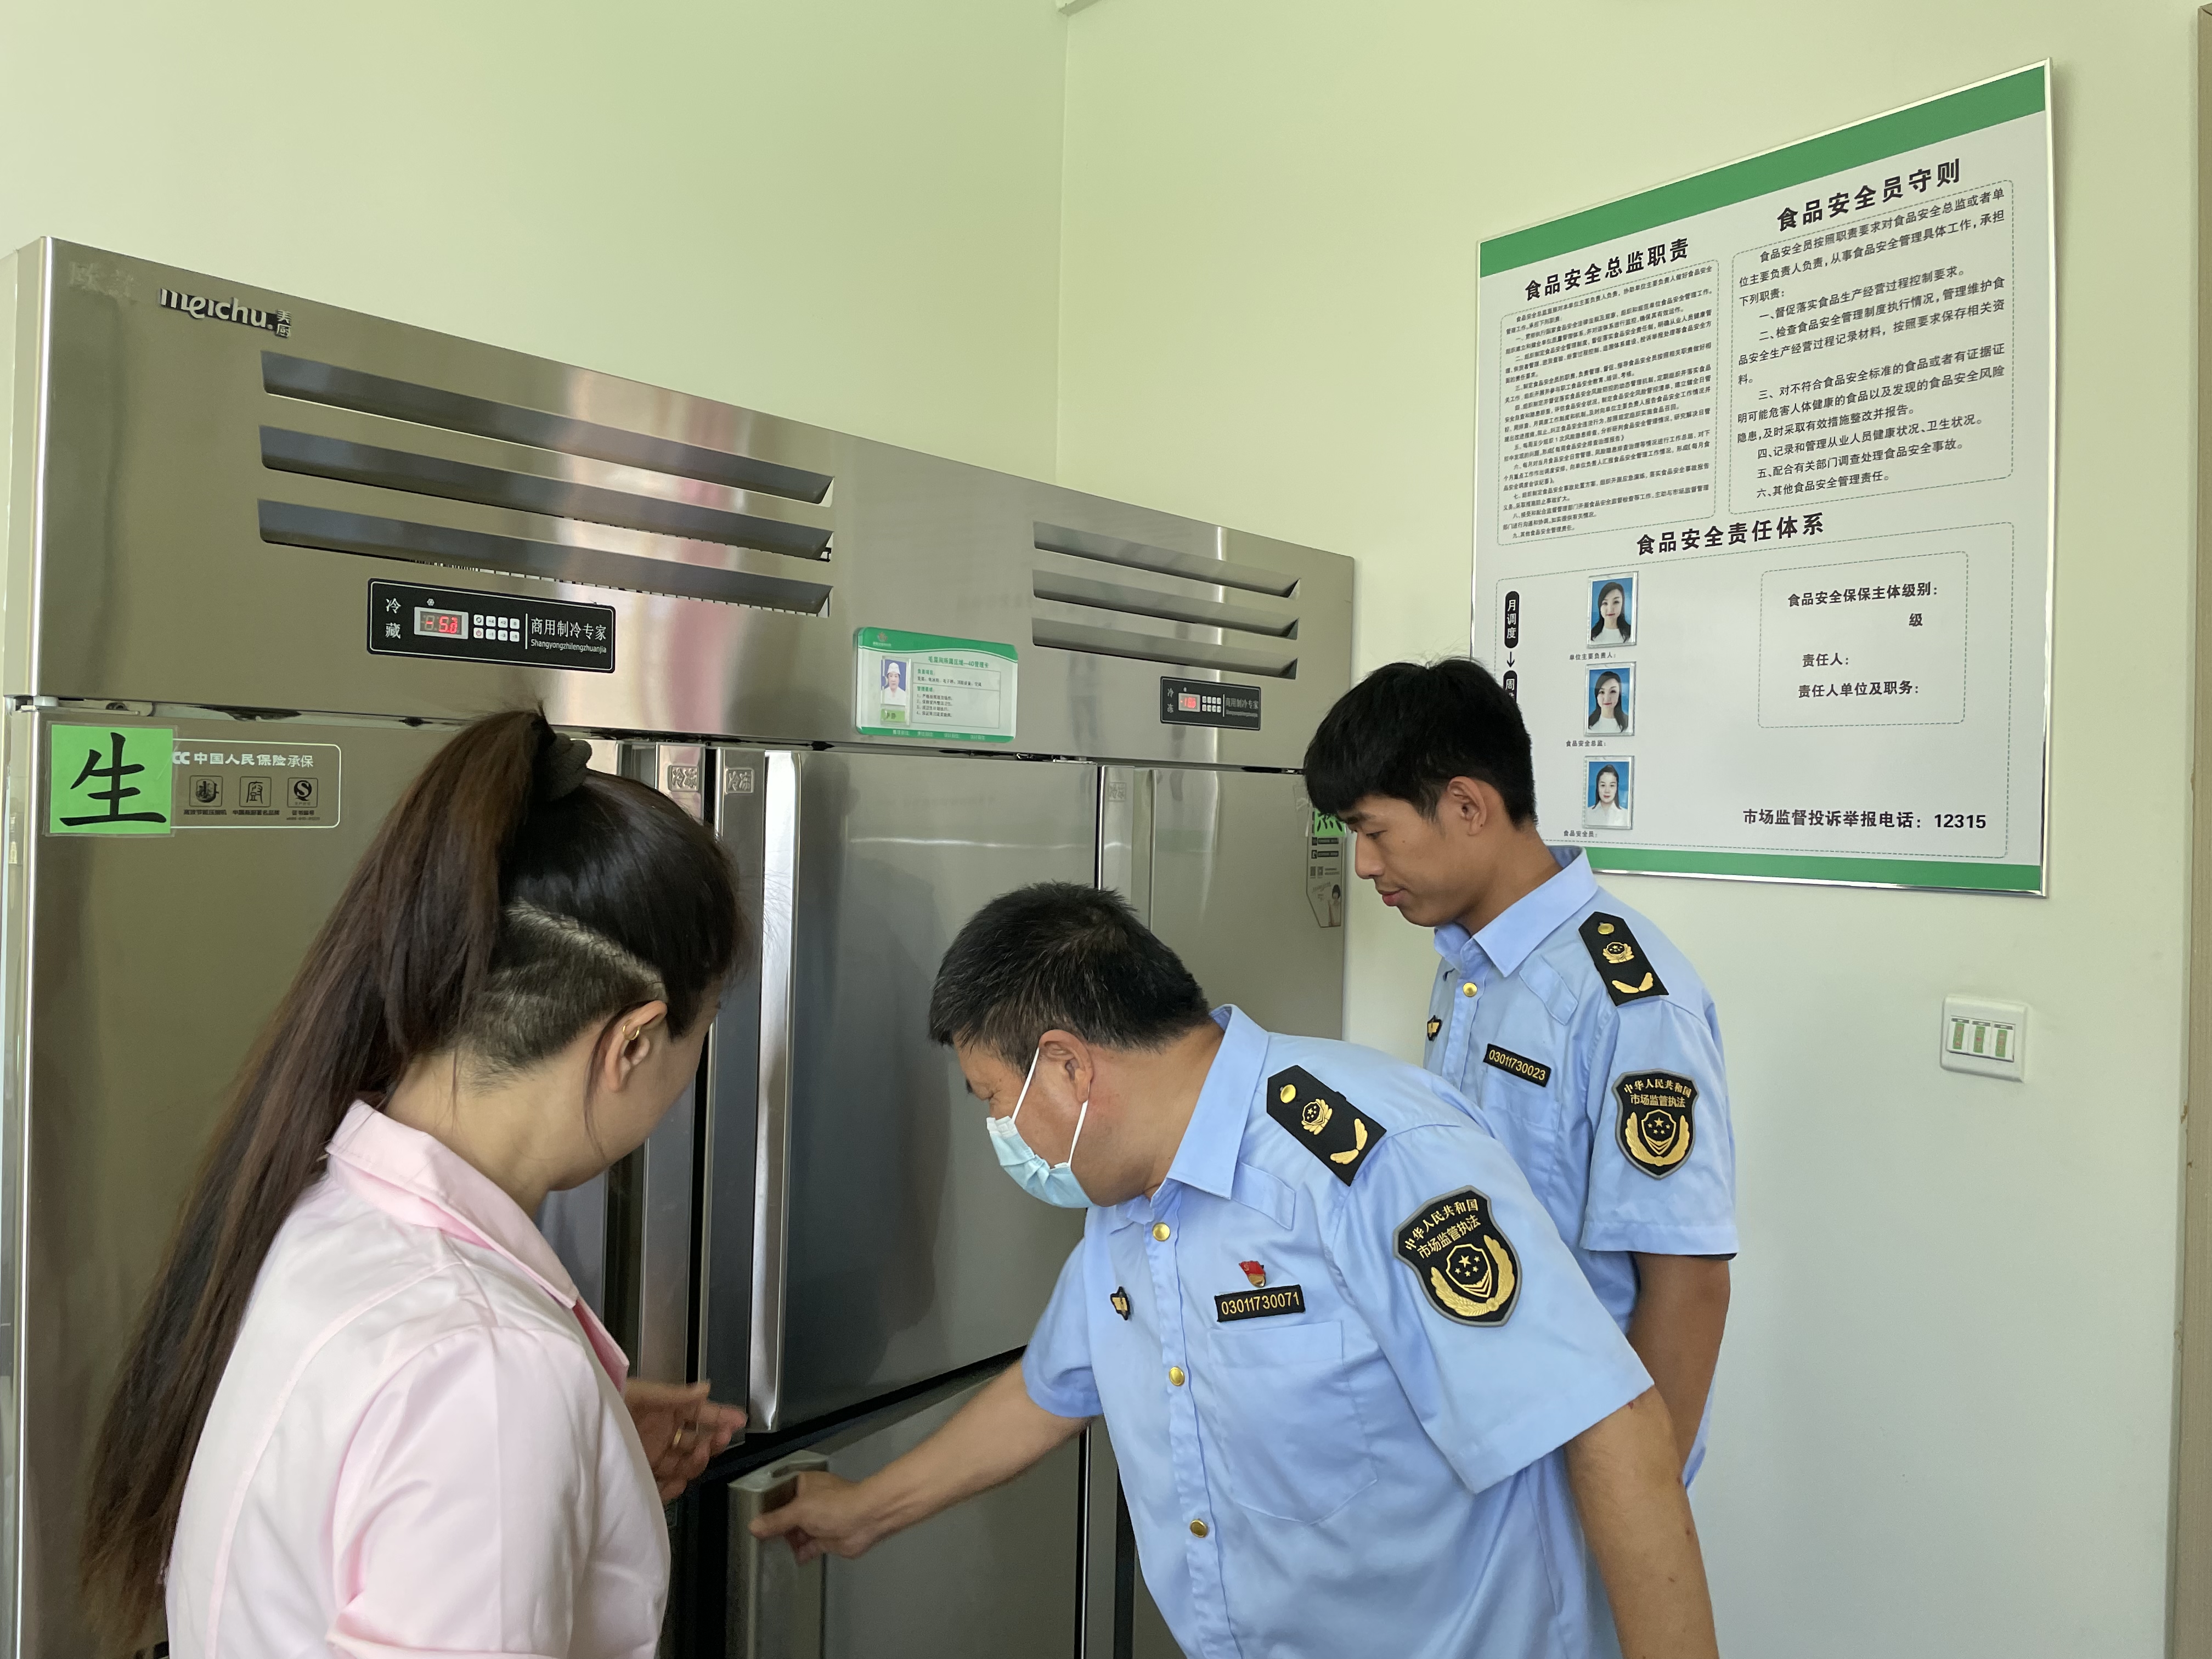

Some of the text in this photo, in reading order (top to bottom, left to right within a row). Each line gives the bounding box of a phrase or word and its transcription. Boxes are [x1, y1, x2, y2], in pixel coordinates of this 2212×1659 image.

[1776, 157, 1960, 232] 食品安全员守则
[1525, 238, 1689, 302] 食品安全总监职责
[1737, 370, 1753, 386] 料。
[1636, 512, 1824, 556] 食品安全责任体系
[1787, 581, 1937, 607] 食品安全保保主体级别：
[385, 597, 402, 640] 冷藏
[531, 617, 607, 642] 商用制冷专家
[1506, 599, 1517, 640] 月调度
[1908, 612, 1923, 628] 级
[1802, 652, 1849, 668] 责任人：
[1798, 680, 1918, 699] 责任人单位及职务：
[1225, 697, 1259, 710] 商用制冷专家
[59, 732, 167, 827] 生
[1934, 814, 1987, 830] 12315
[1488, 1048, 1547, 1082] 03011730023
[1623, 1078, 1693, 1098] 中华人民共和国
[1630, 1093, 1687, 1110] 市场监管执法
[1405, 1197, 1480, 1251] 中华人民共和国
[1417, 1215, 1482, 1260] 市场监管执法
[1220, 1291, 1301, 1316] 03011730071
